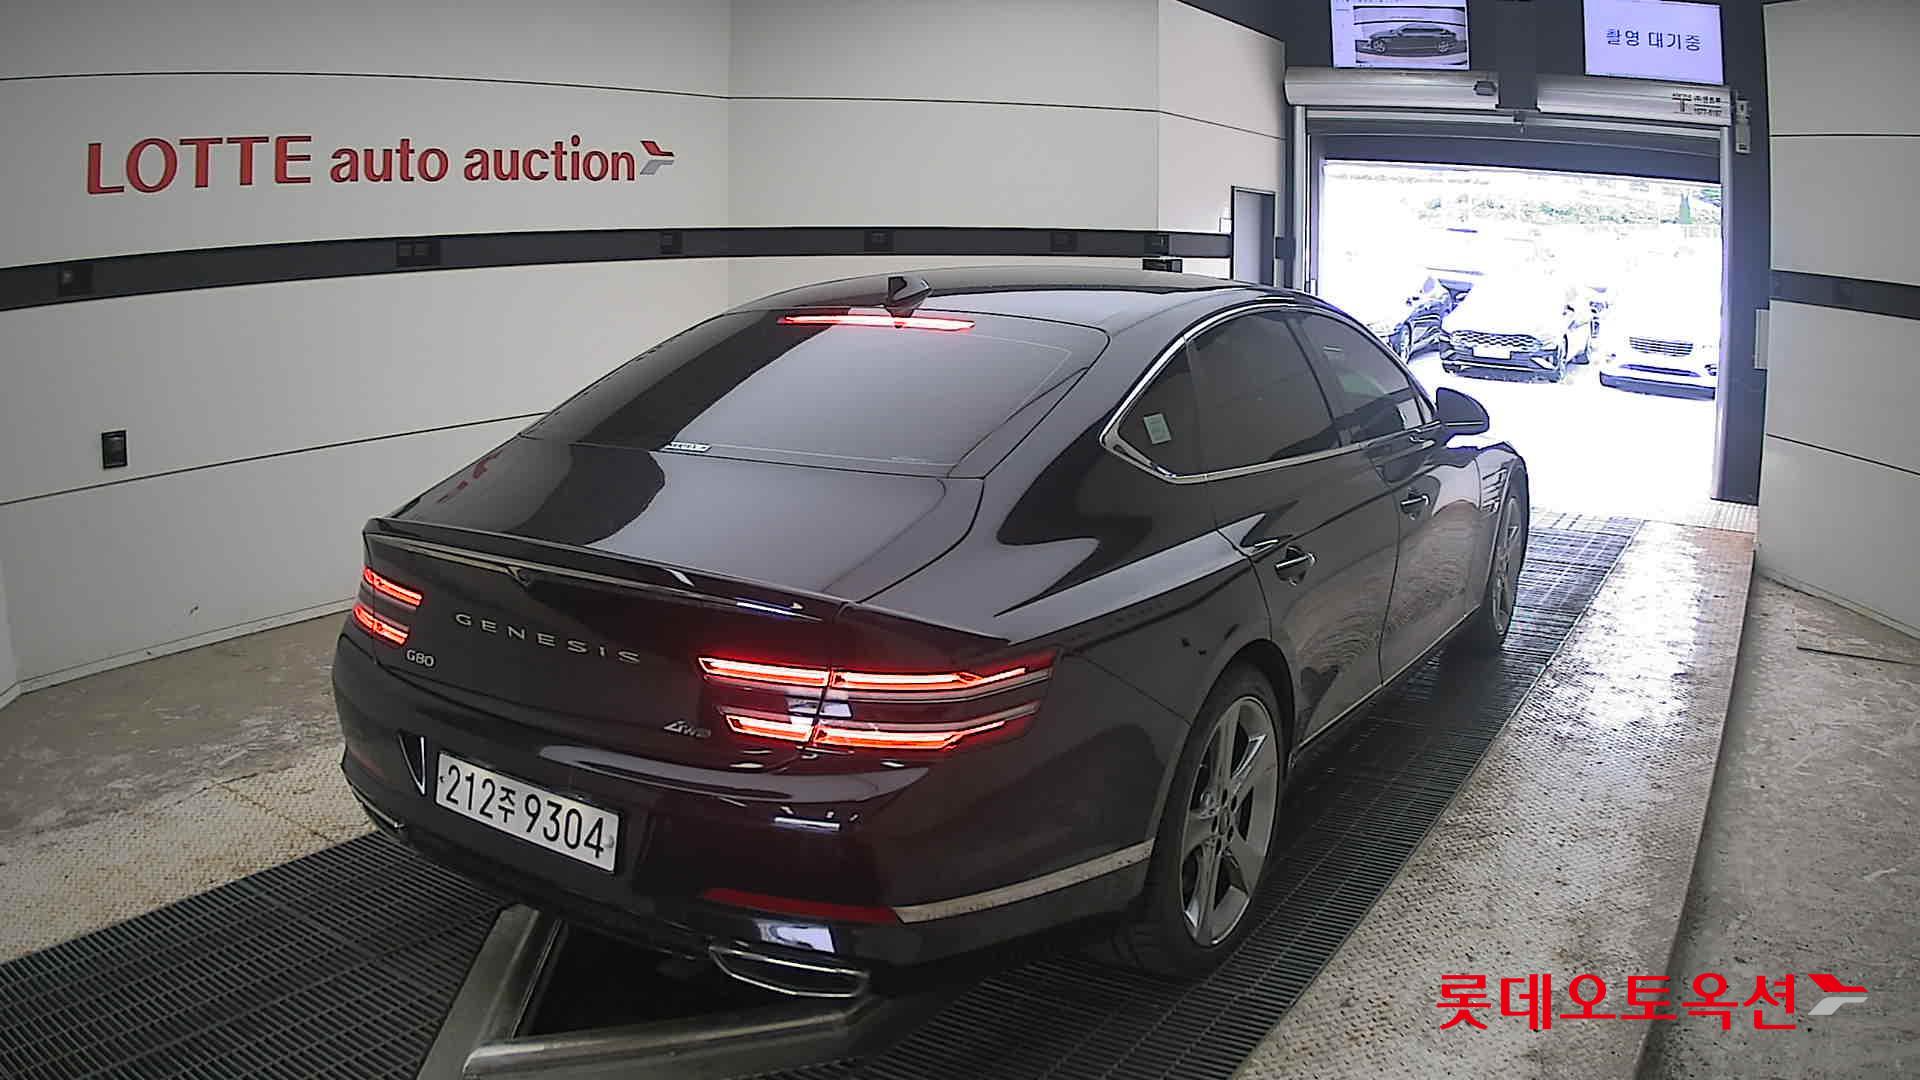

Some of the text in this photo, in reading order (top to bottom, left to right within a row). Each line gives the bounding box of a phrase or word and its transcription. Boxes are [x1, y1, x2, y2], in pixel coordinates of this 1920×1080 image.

[1648, 31, 1701, 52] 대기중
[86, 134, 636, 195] LOTTE auto auction
[406, 649, 435, 667] G80
[454, 612, 642, 665] GENESIS
[523, 799, 606, 860] 9304
